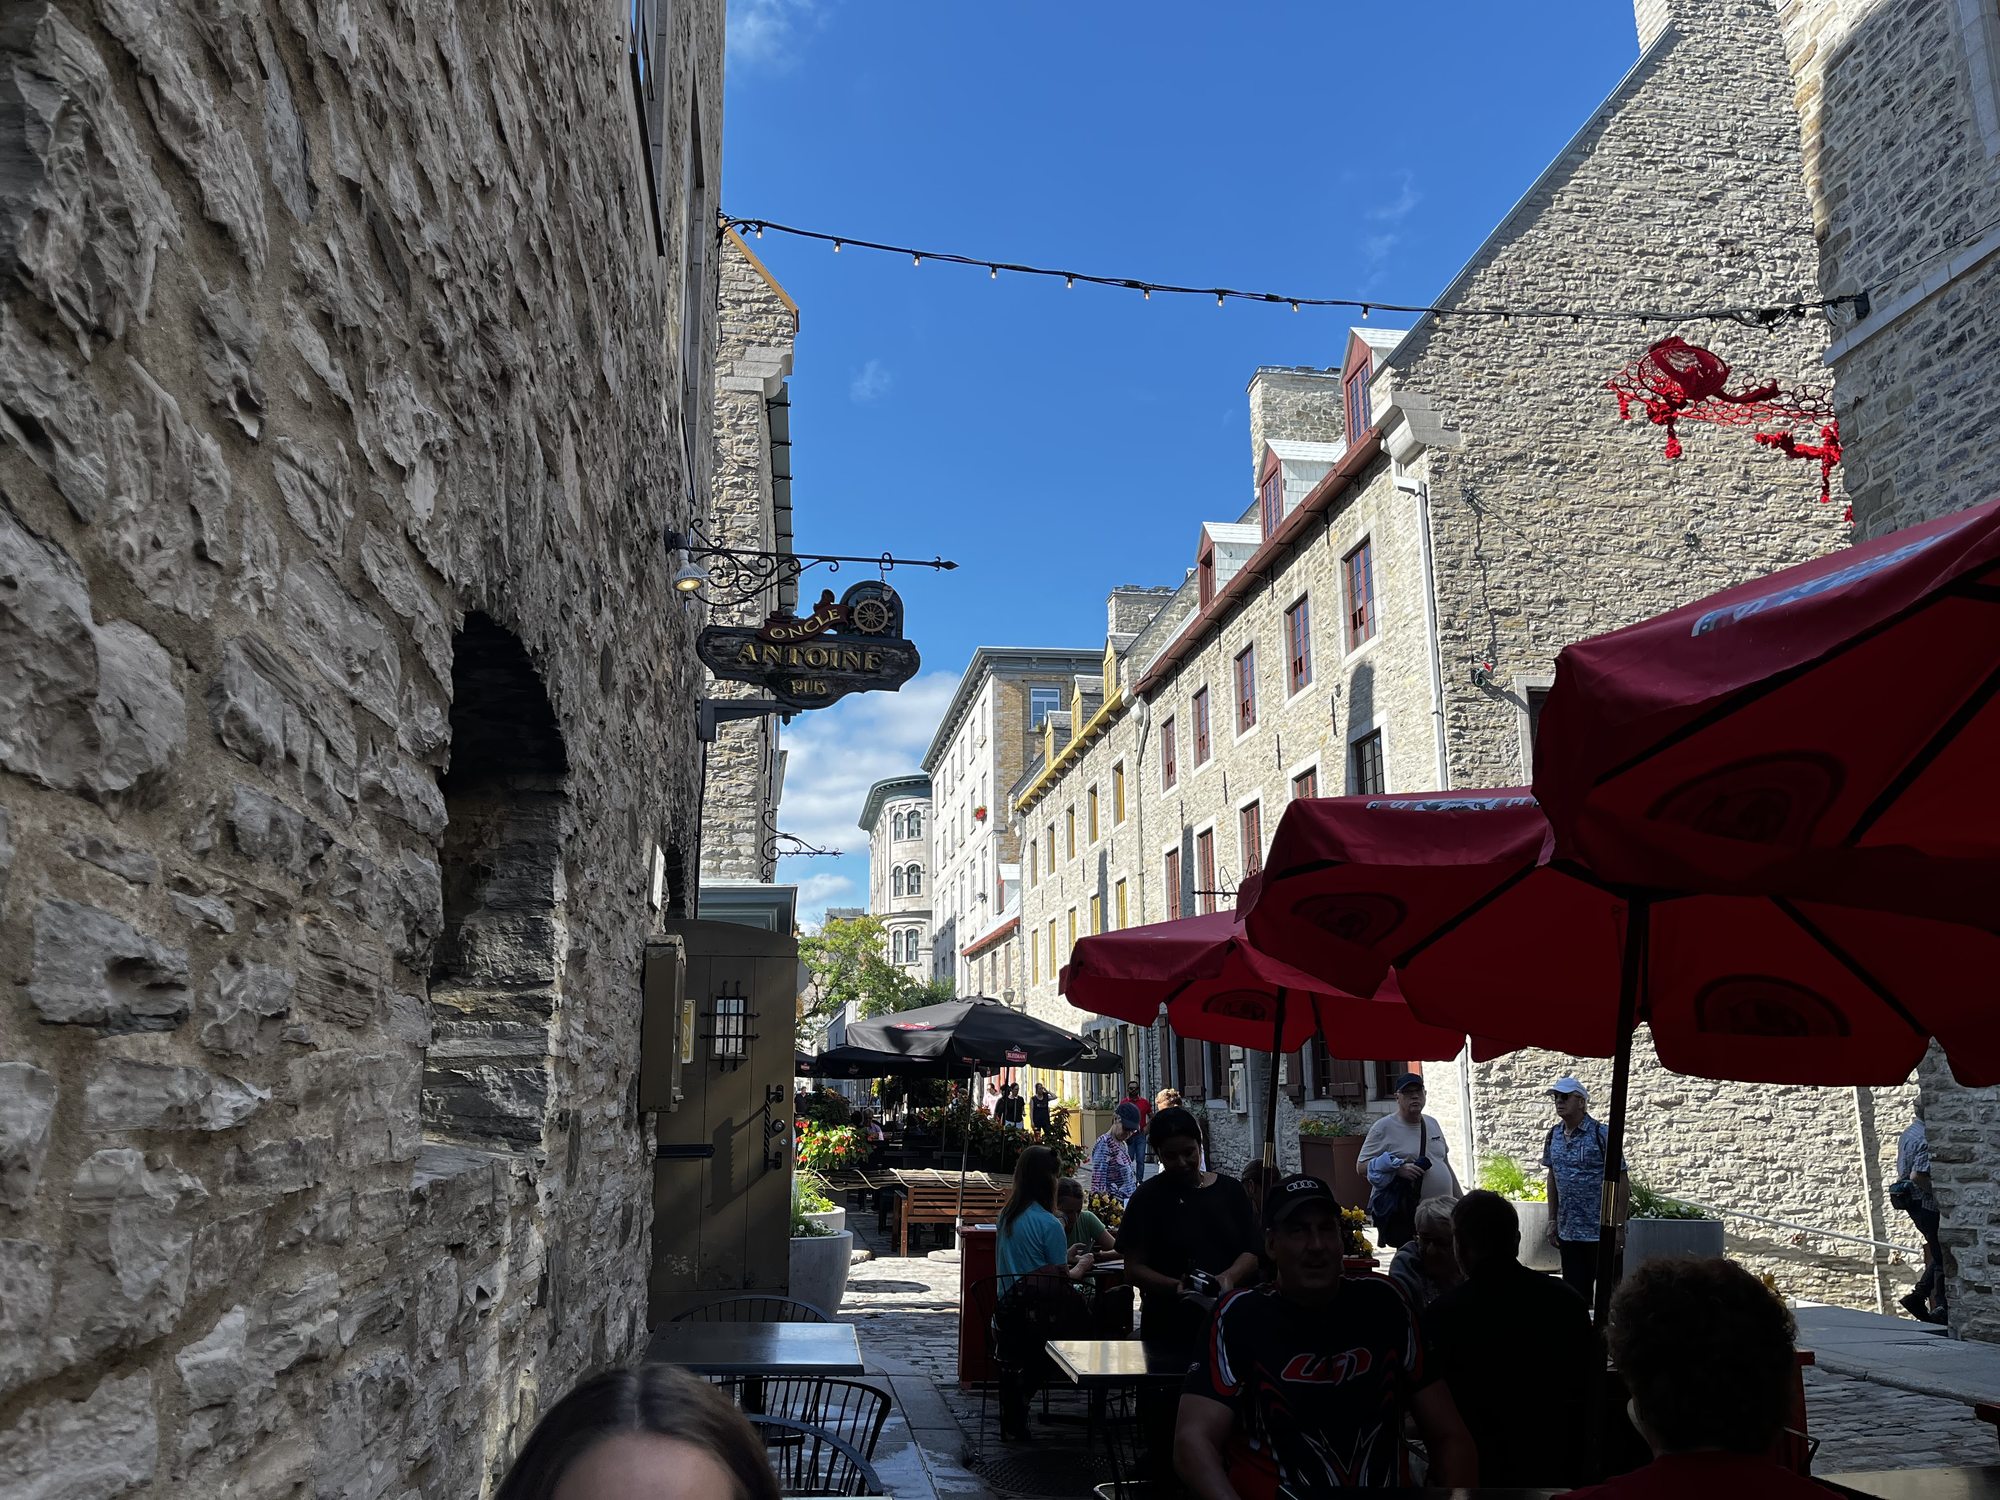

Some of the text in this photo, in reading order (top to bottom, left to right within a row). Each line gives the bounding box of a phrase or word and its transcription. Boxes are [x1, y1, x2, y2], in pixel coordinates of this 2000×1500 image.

[769, 608, 841, 639] ONCLE
[736, 642, 883, 672] ANTOINE
[790, 679, 827, 695] PUB
